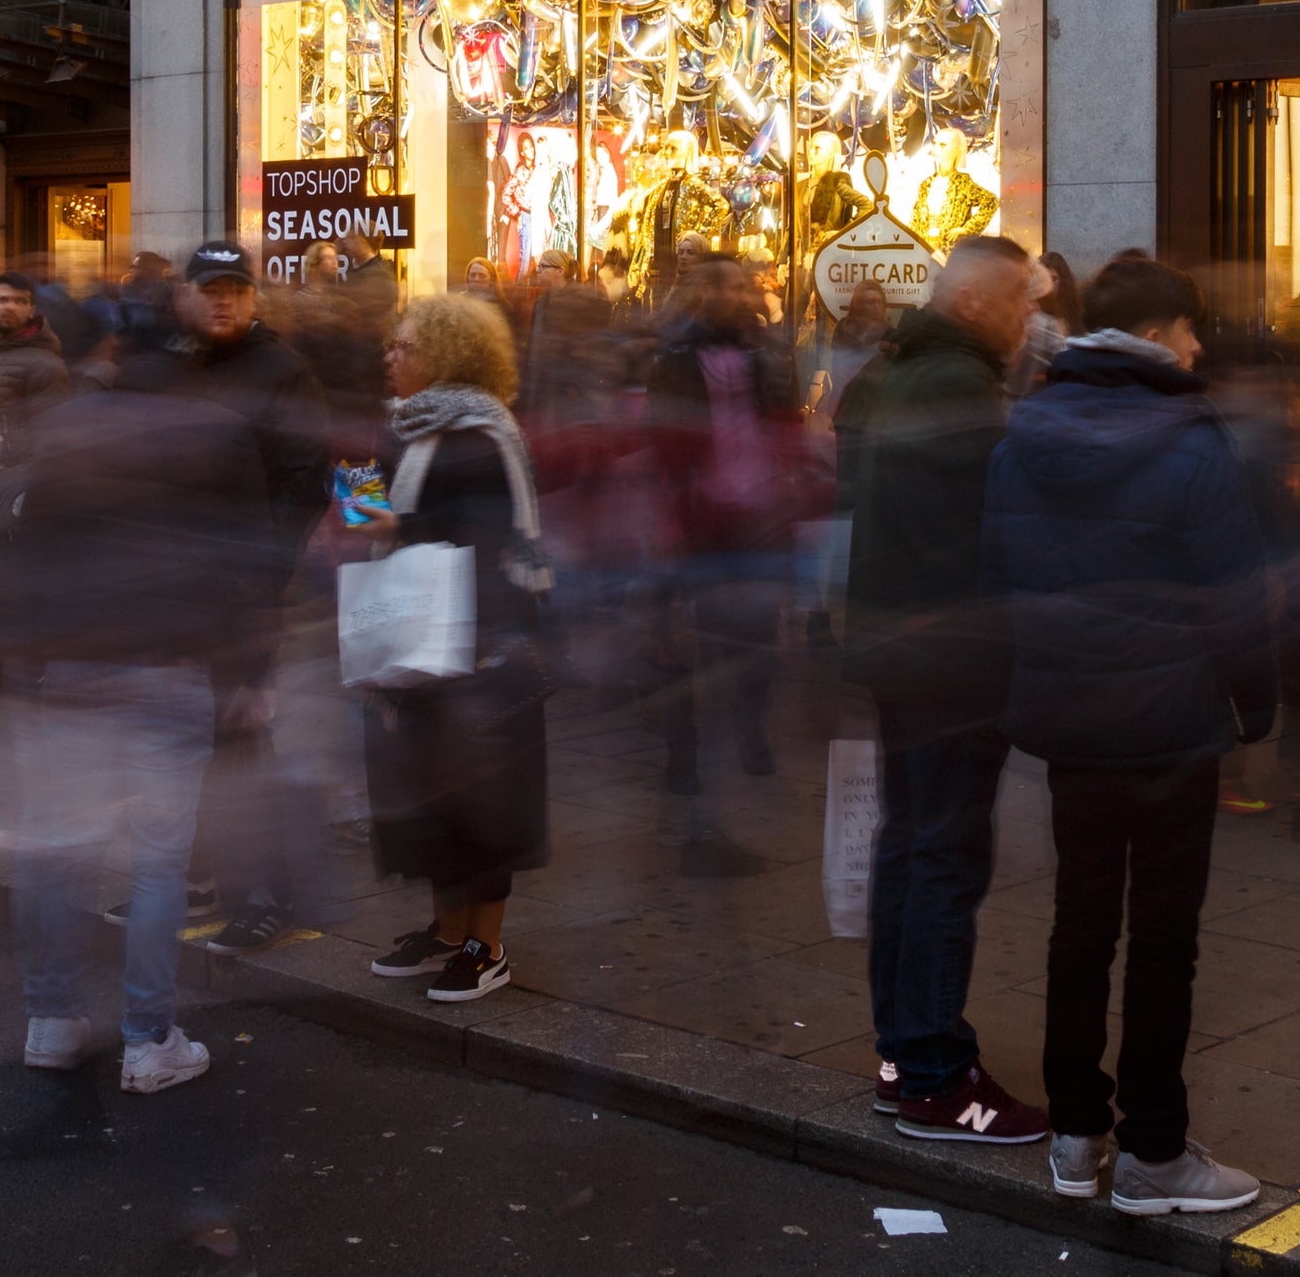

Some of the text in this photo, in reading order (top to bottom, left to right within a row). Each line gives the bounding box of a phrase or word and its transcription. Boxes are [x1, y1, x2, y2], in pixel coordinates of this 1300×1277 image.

[267, 168, 361, 197] TOPSHOP
[267, 205, 408, 241] SEASONAL
[828, 263, 929, 284] GIFT CARD
[956, 1101, 998, 1133] N
